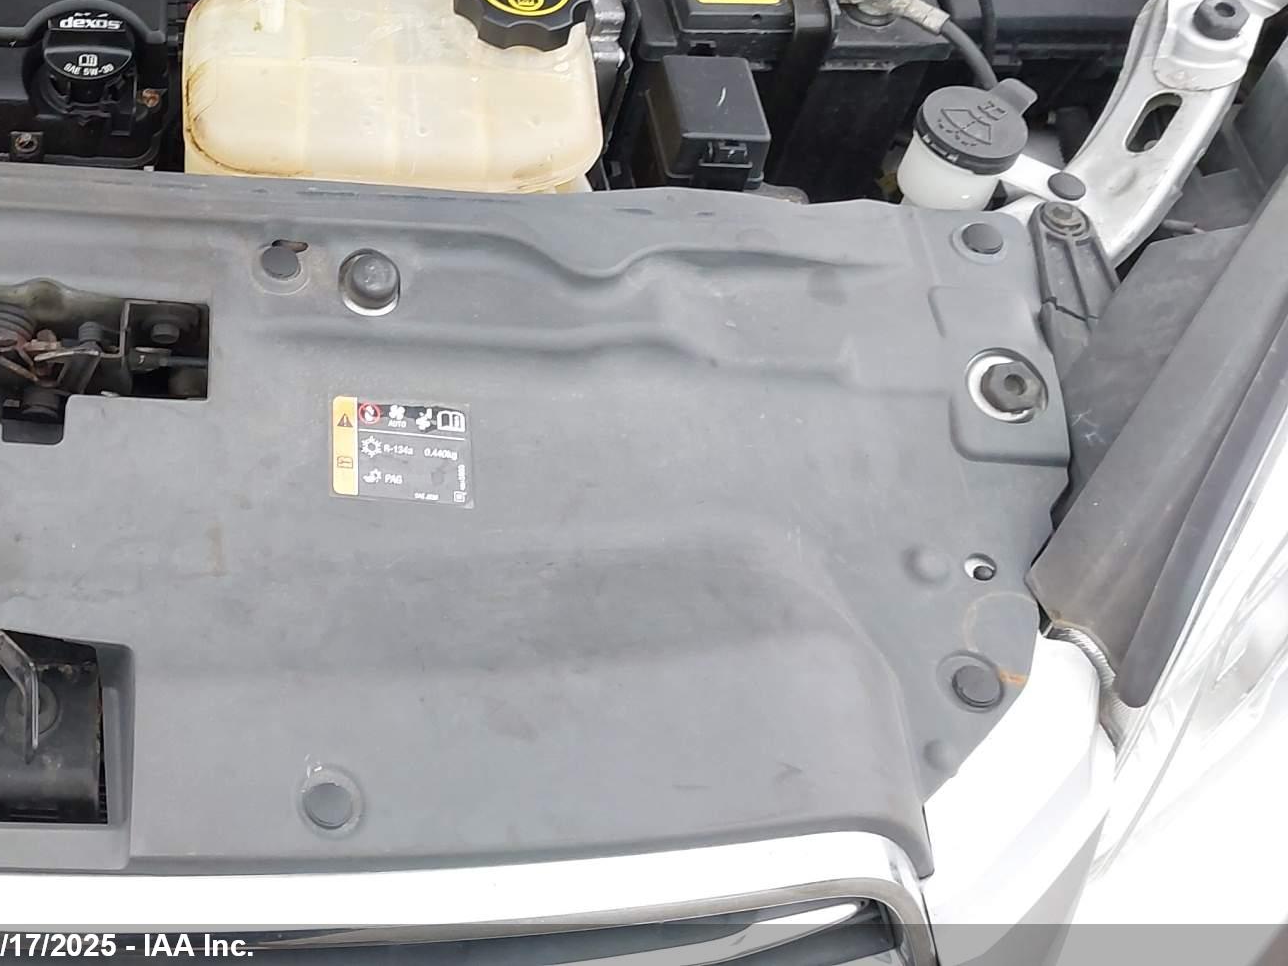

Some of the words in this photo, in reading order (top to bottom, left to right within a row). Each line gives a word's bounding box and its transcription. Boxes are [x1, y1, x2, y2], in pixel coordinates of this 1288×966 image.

[60, 16, 123, 30] dexos
[64, 63, 81, 75] SAE
[388, 420, 407, 428] AUTO
[383, 444, 414, 455] R-134a
[424, 447, 458, 461] 0.440kg
